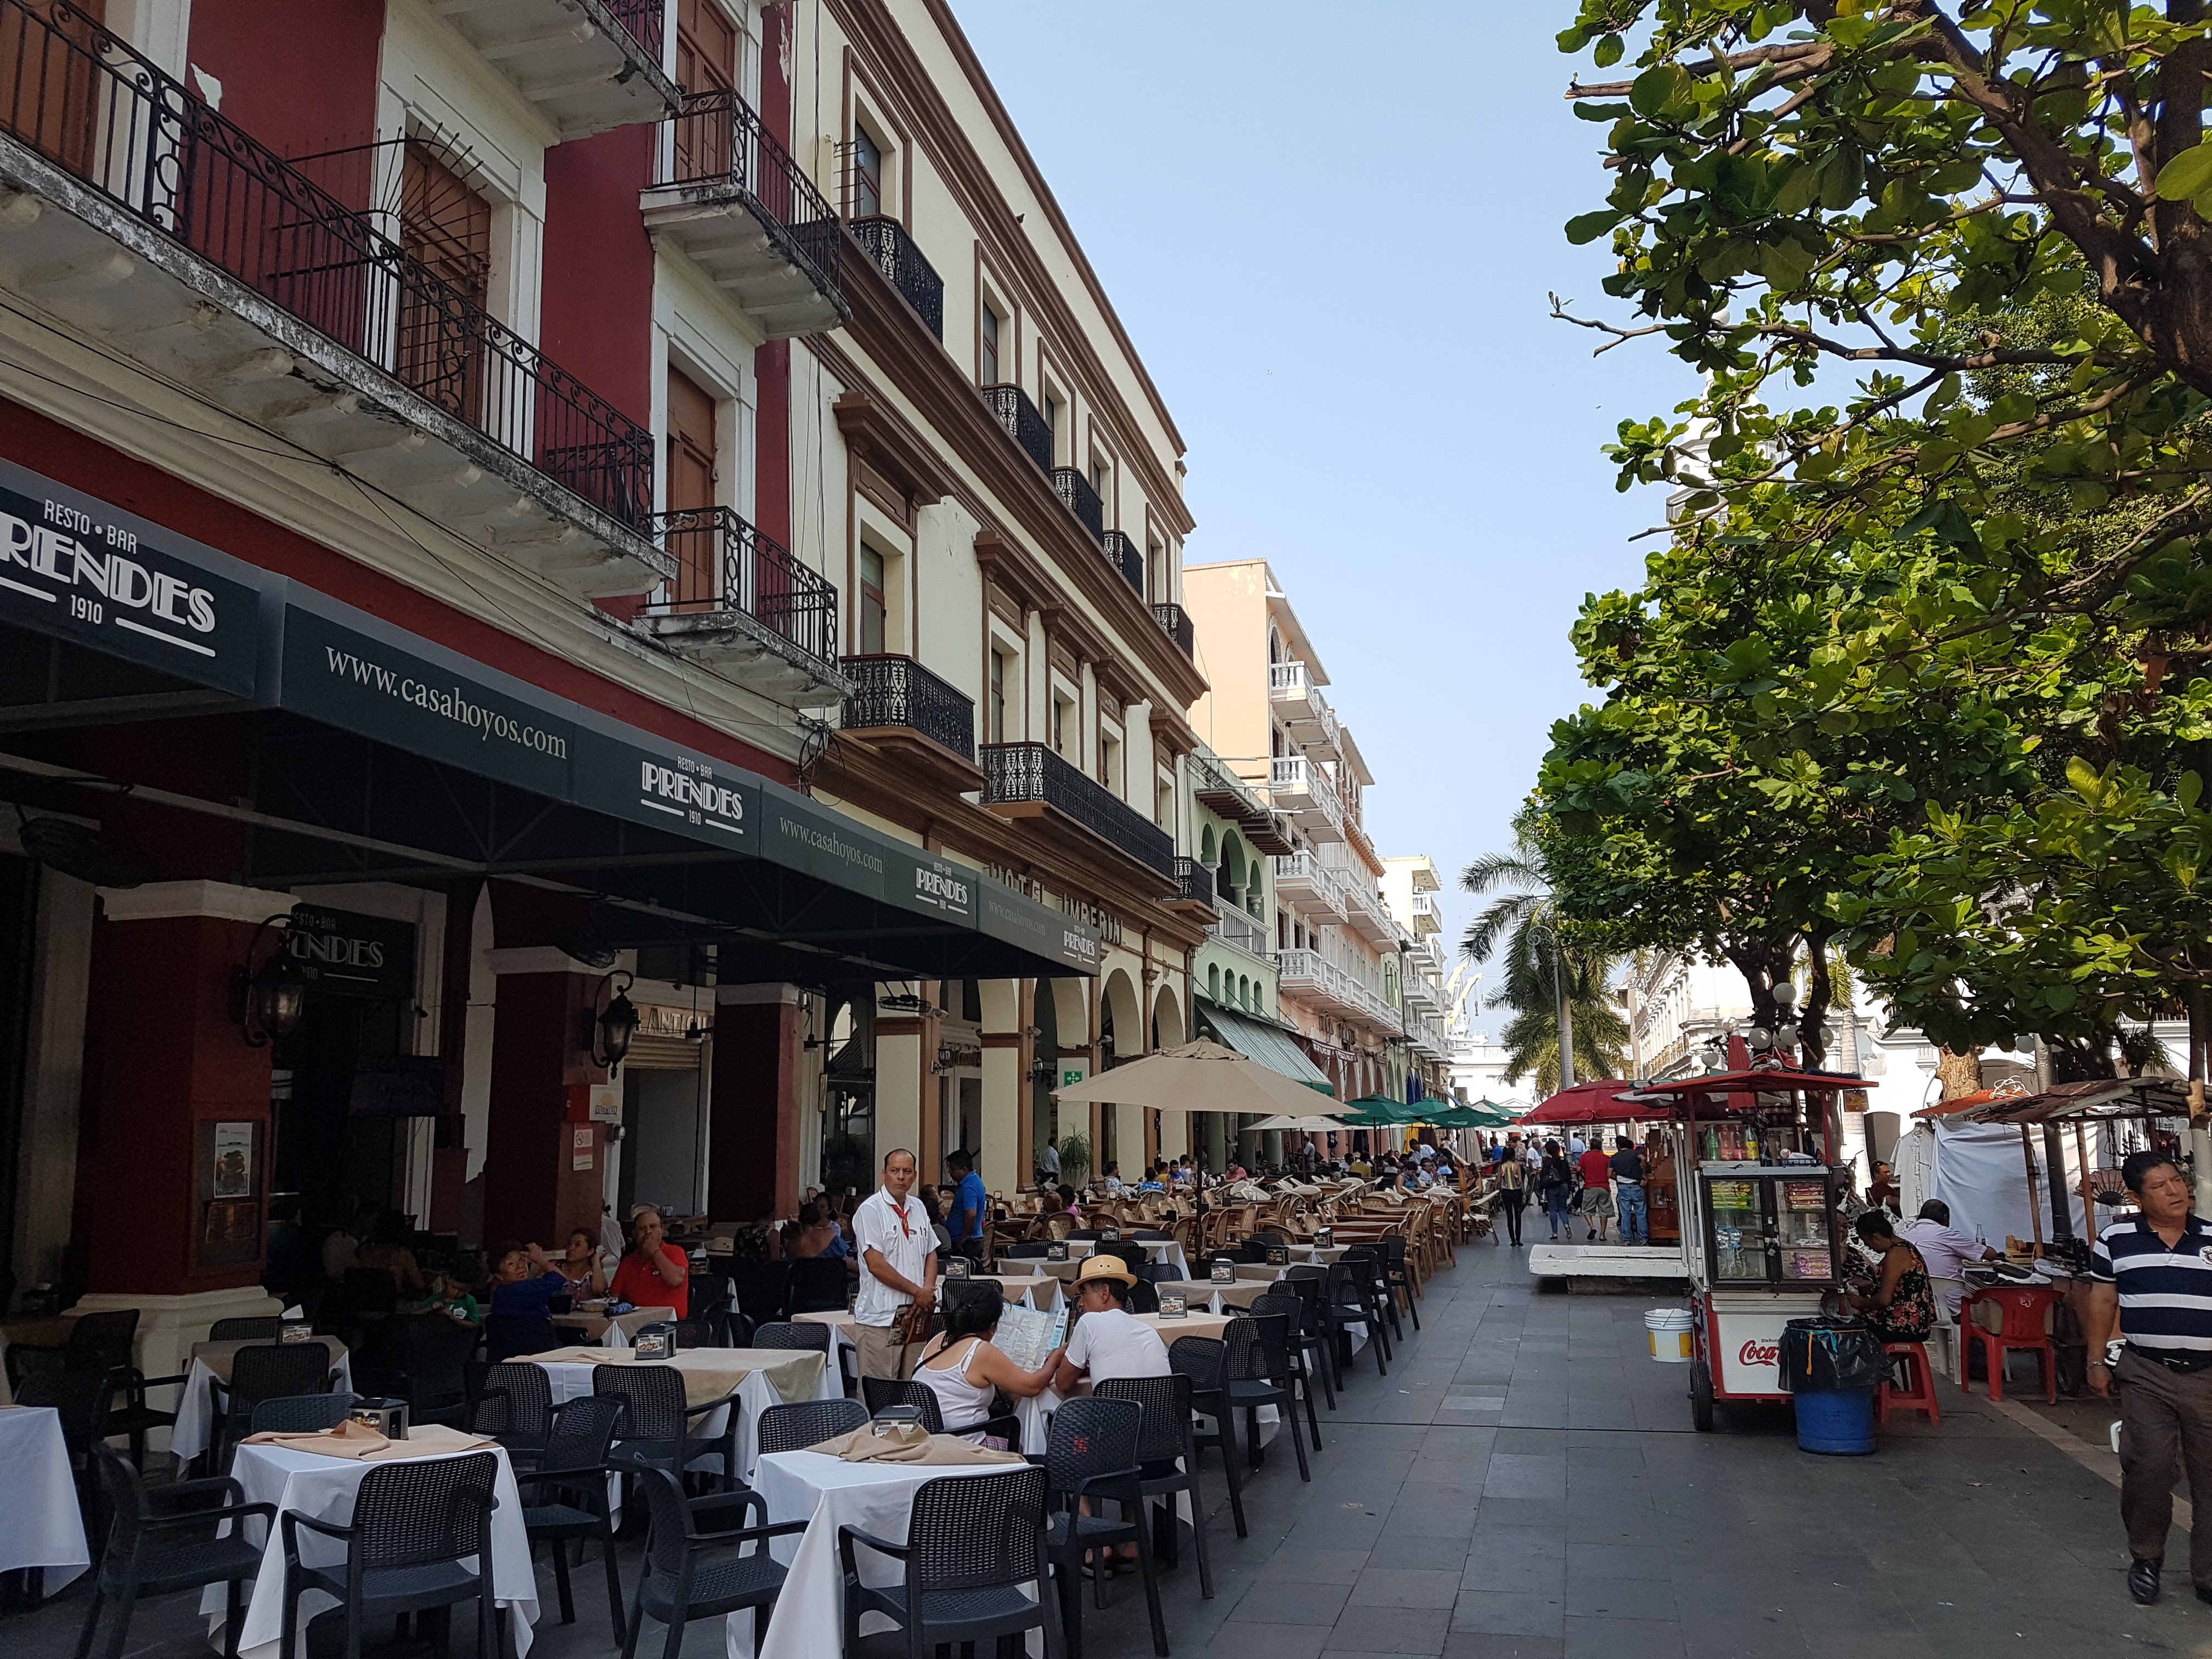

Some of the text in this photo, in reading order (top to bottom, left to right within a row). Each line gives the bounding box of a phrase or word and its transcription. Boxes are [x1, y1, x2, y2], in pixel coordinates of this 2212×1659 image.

[44, 499, 137, 554] RESTO BAR
[71, 595, 103, 625] 1910
[325, 646, 567, 760] www.casahoyos.com
[678, 756, 712, 780] RESTO BAR
[641, 761, 743, 820] PRENDES
[688, 810, 702, 826] 1910
[779, 817, 883, 874] www.casahoyos.com
[916, 867, 968, 905] PRENDES
[1063, 930, 1096, 957] PRENDES
